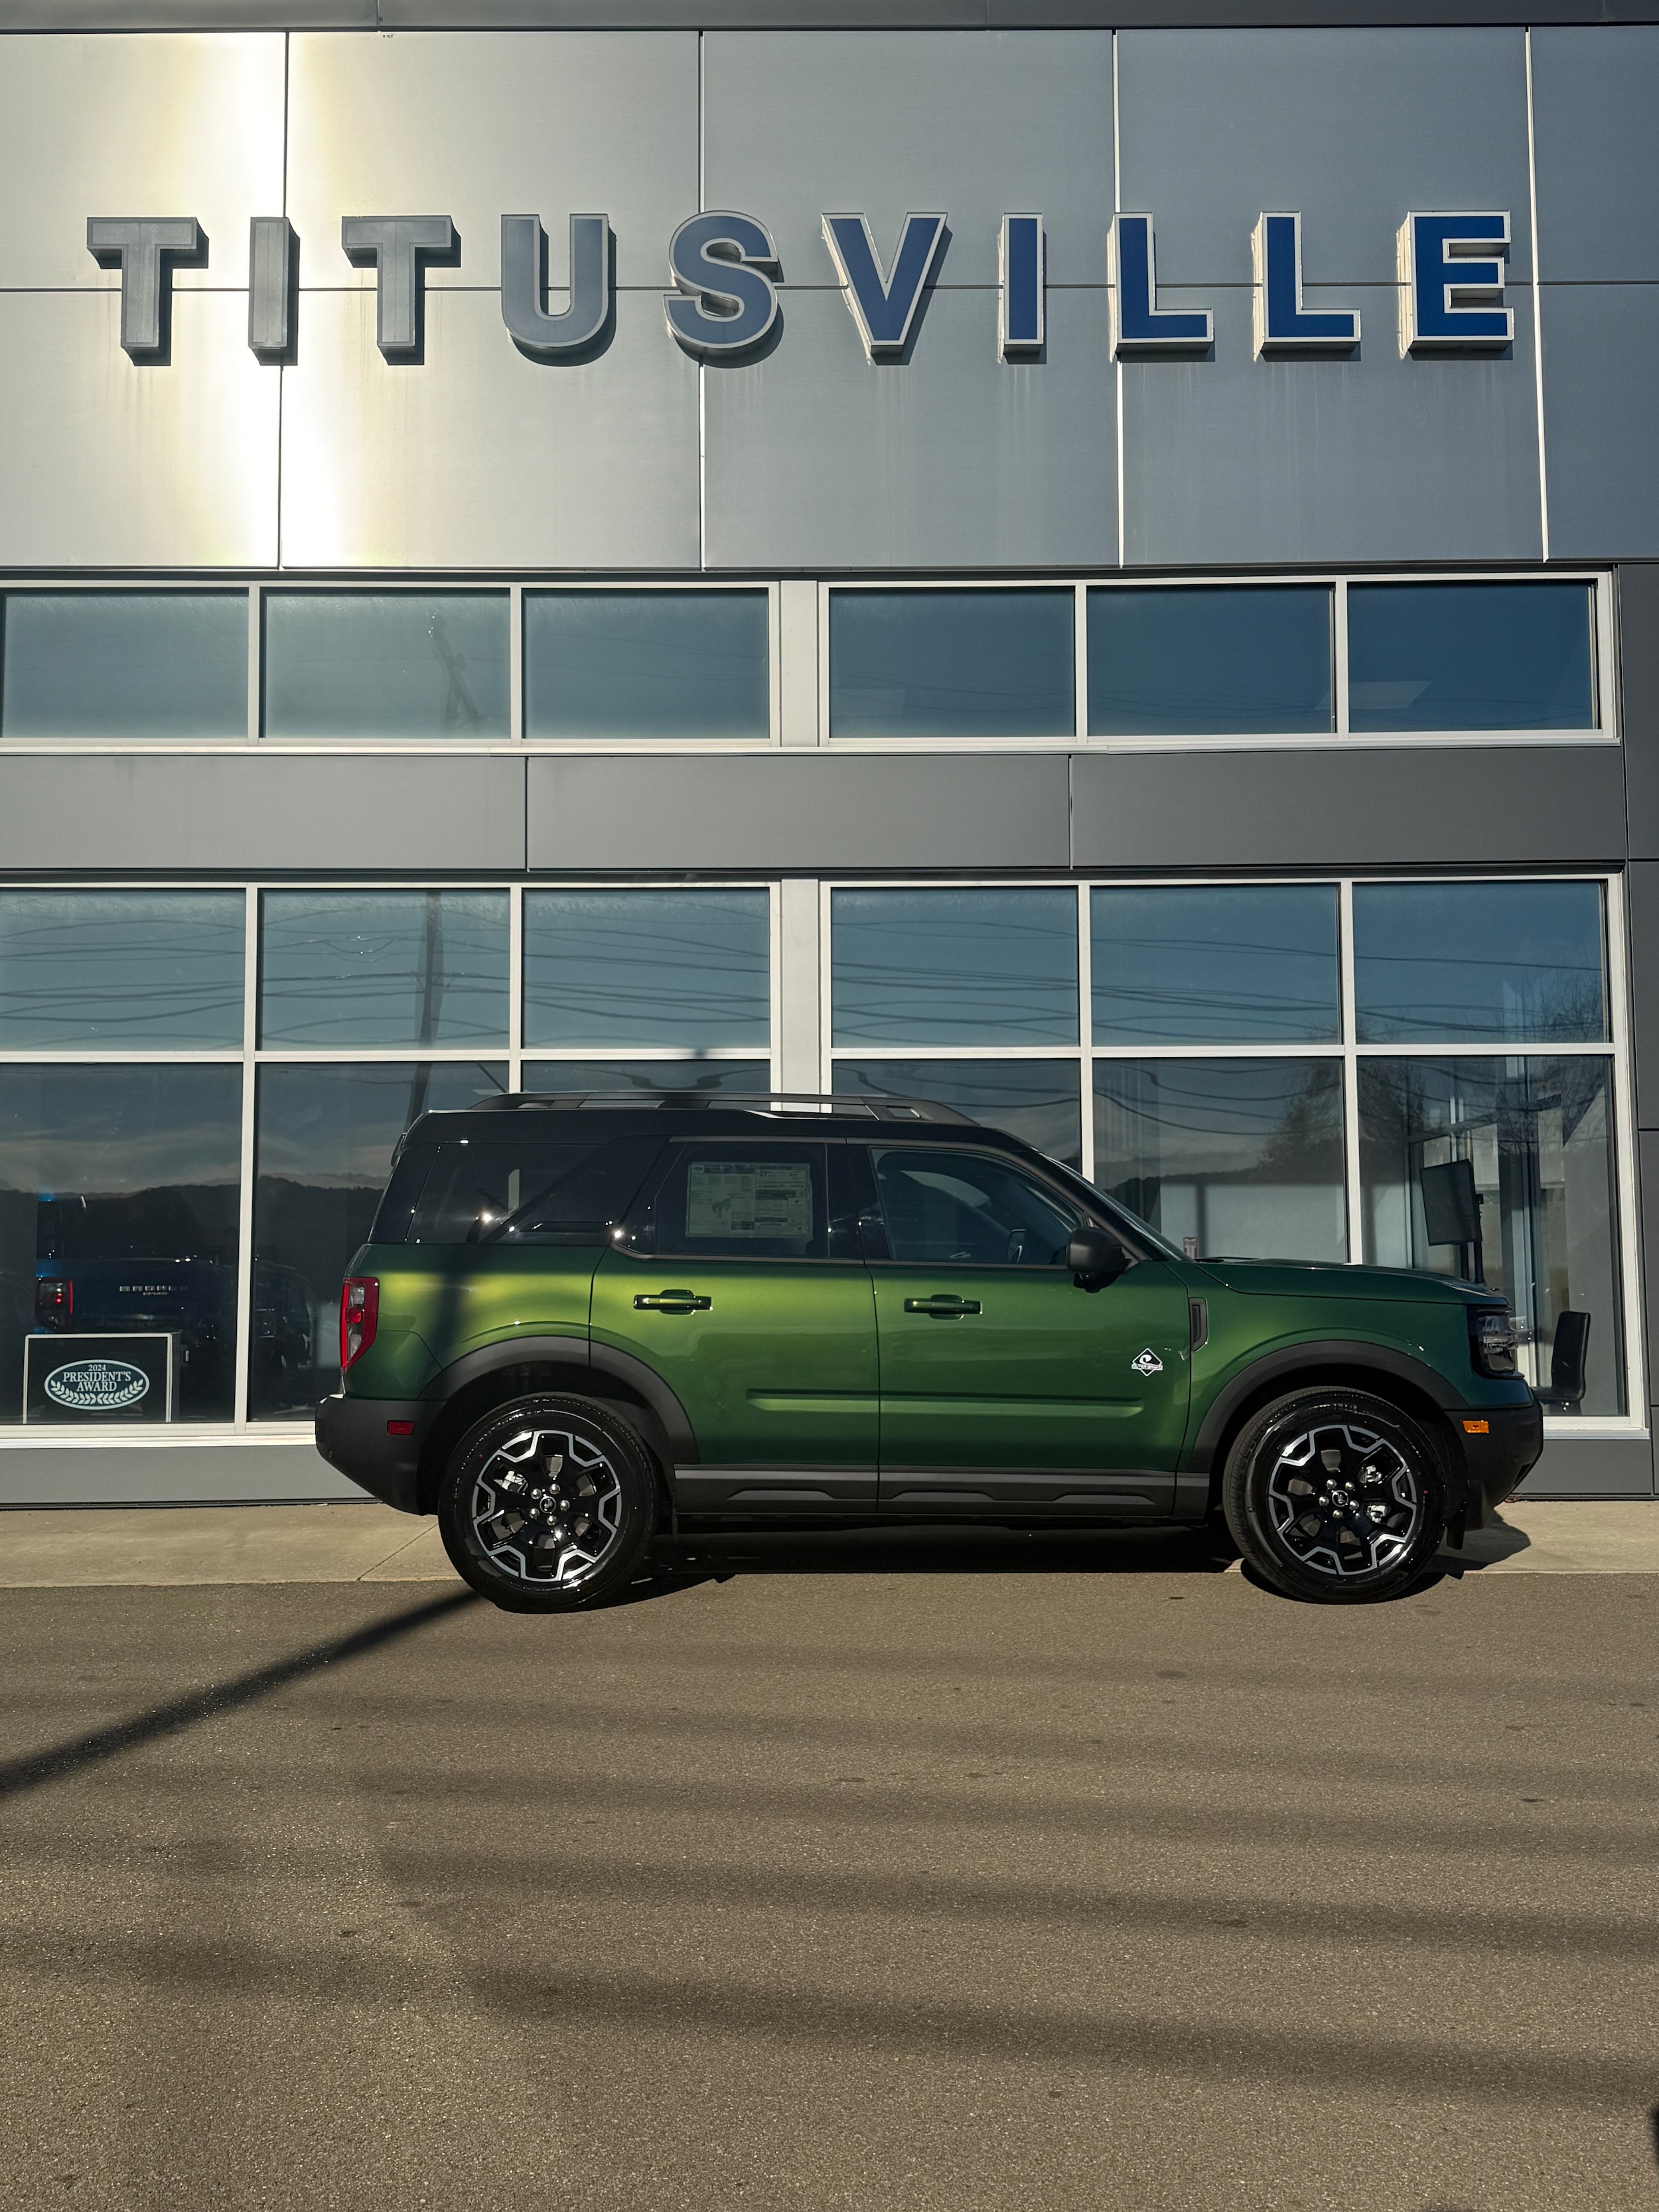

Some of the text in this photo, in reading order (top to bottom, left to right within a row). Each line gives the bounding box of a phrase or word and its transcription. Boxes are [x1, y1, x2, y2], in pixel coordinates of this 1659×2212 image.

[87, 210, 1514, 352] TITUSVILLE
[63, 1371, 131, 1382] PRESIDENT'S
[76, 1381, 117, 1392] AWARD
